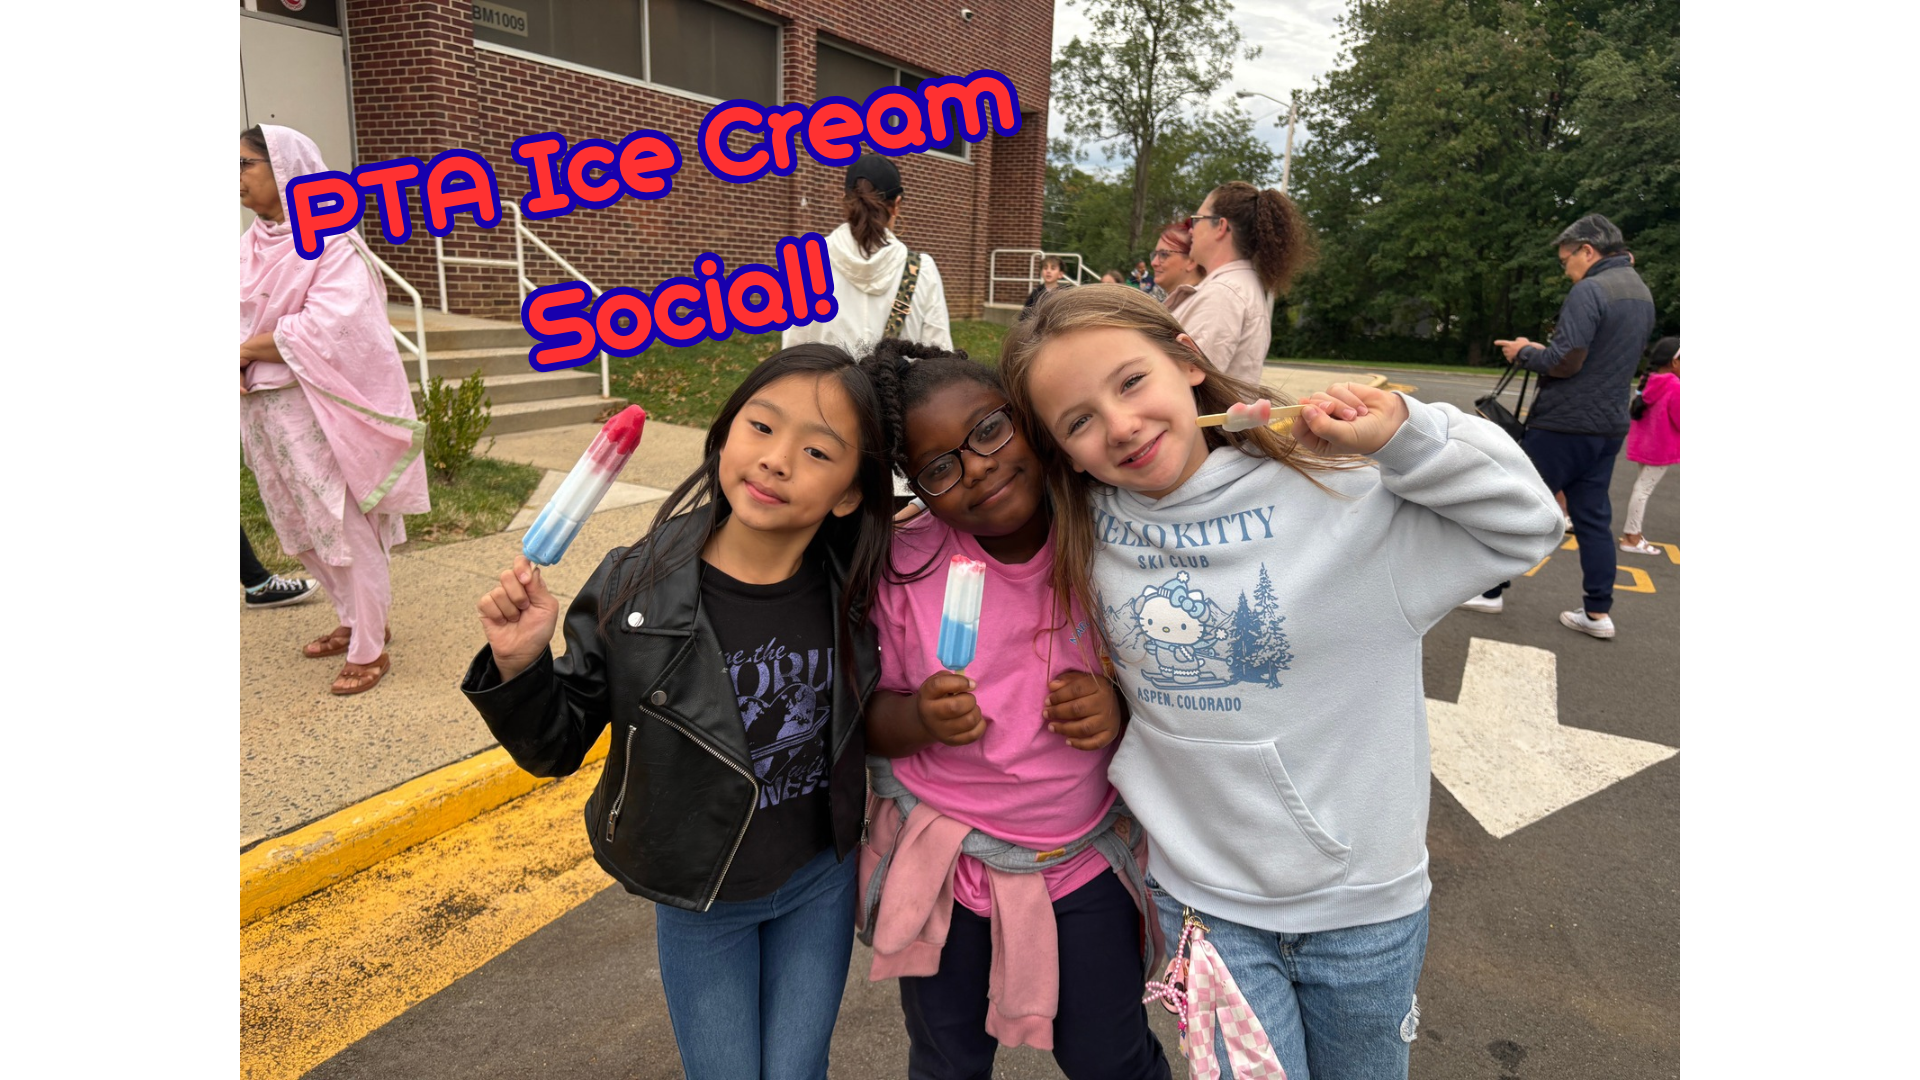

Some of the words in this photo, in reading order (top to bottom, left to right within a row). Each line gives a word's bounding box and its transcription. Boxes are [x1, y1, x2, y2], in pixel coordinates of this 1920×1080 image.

[472, 5, 525, 31] BM1009
[1172, 505, 1275, 549] KITTY
[1138, 555, 1164, 570] SKI
[1169, 555, 1209, 568] CLUB
[753, 637, 786, 663] the
[1177, 695, 1242, 711] COLORADO
